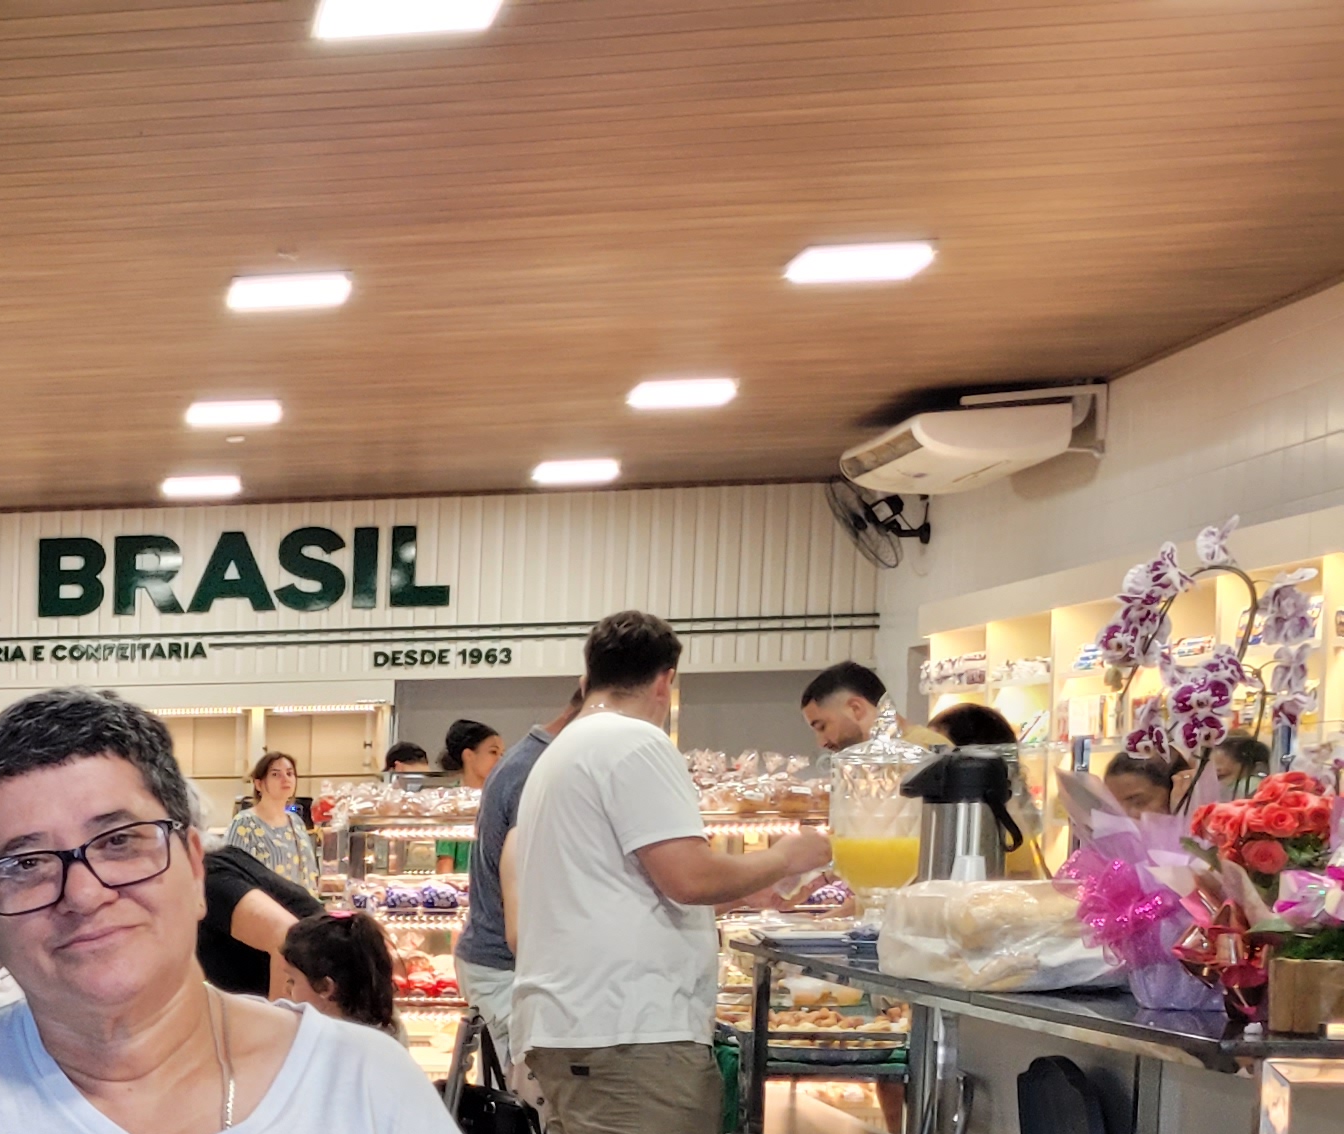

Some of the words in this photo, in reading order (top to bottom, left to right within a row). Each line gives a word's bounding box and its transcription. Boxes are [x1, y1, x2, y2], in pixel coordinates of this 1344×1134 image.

[38, 525, 450, 618] BRASIL
[32, 644, 45, 662] E
[51, 641, 208, 662] CONFEITARIA
[373, 648, 451, 667] DESDE
[457, 647, 512, 665] 1963
